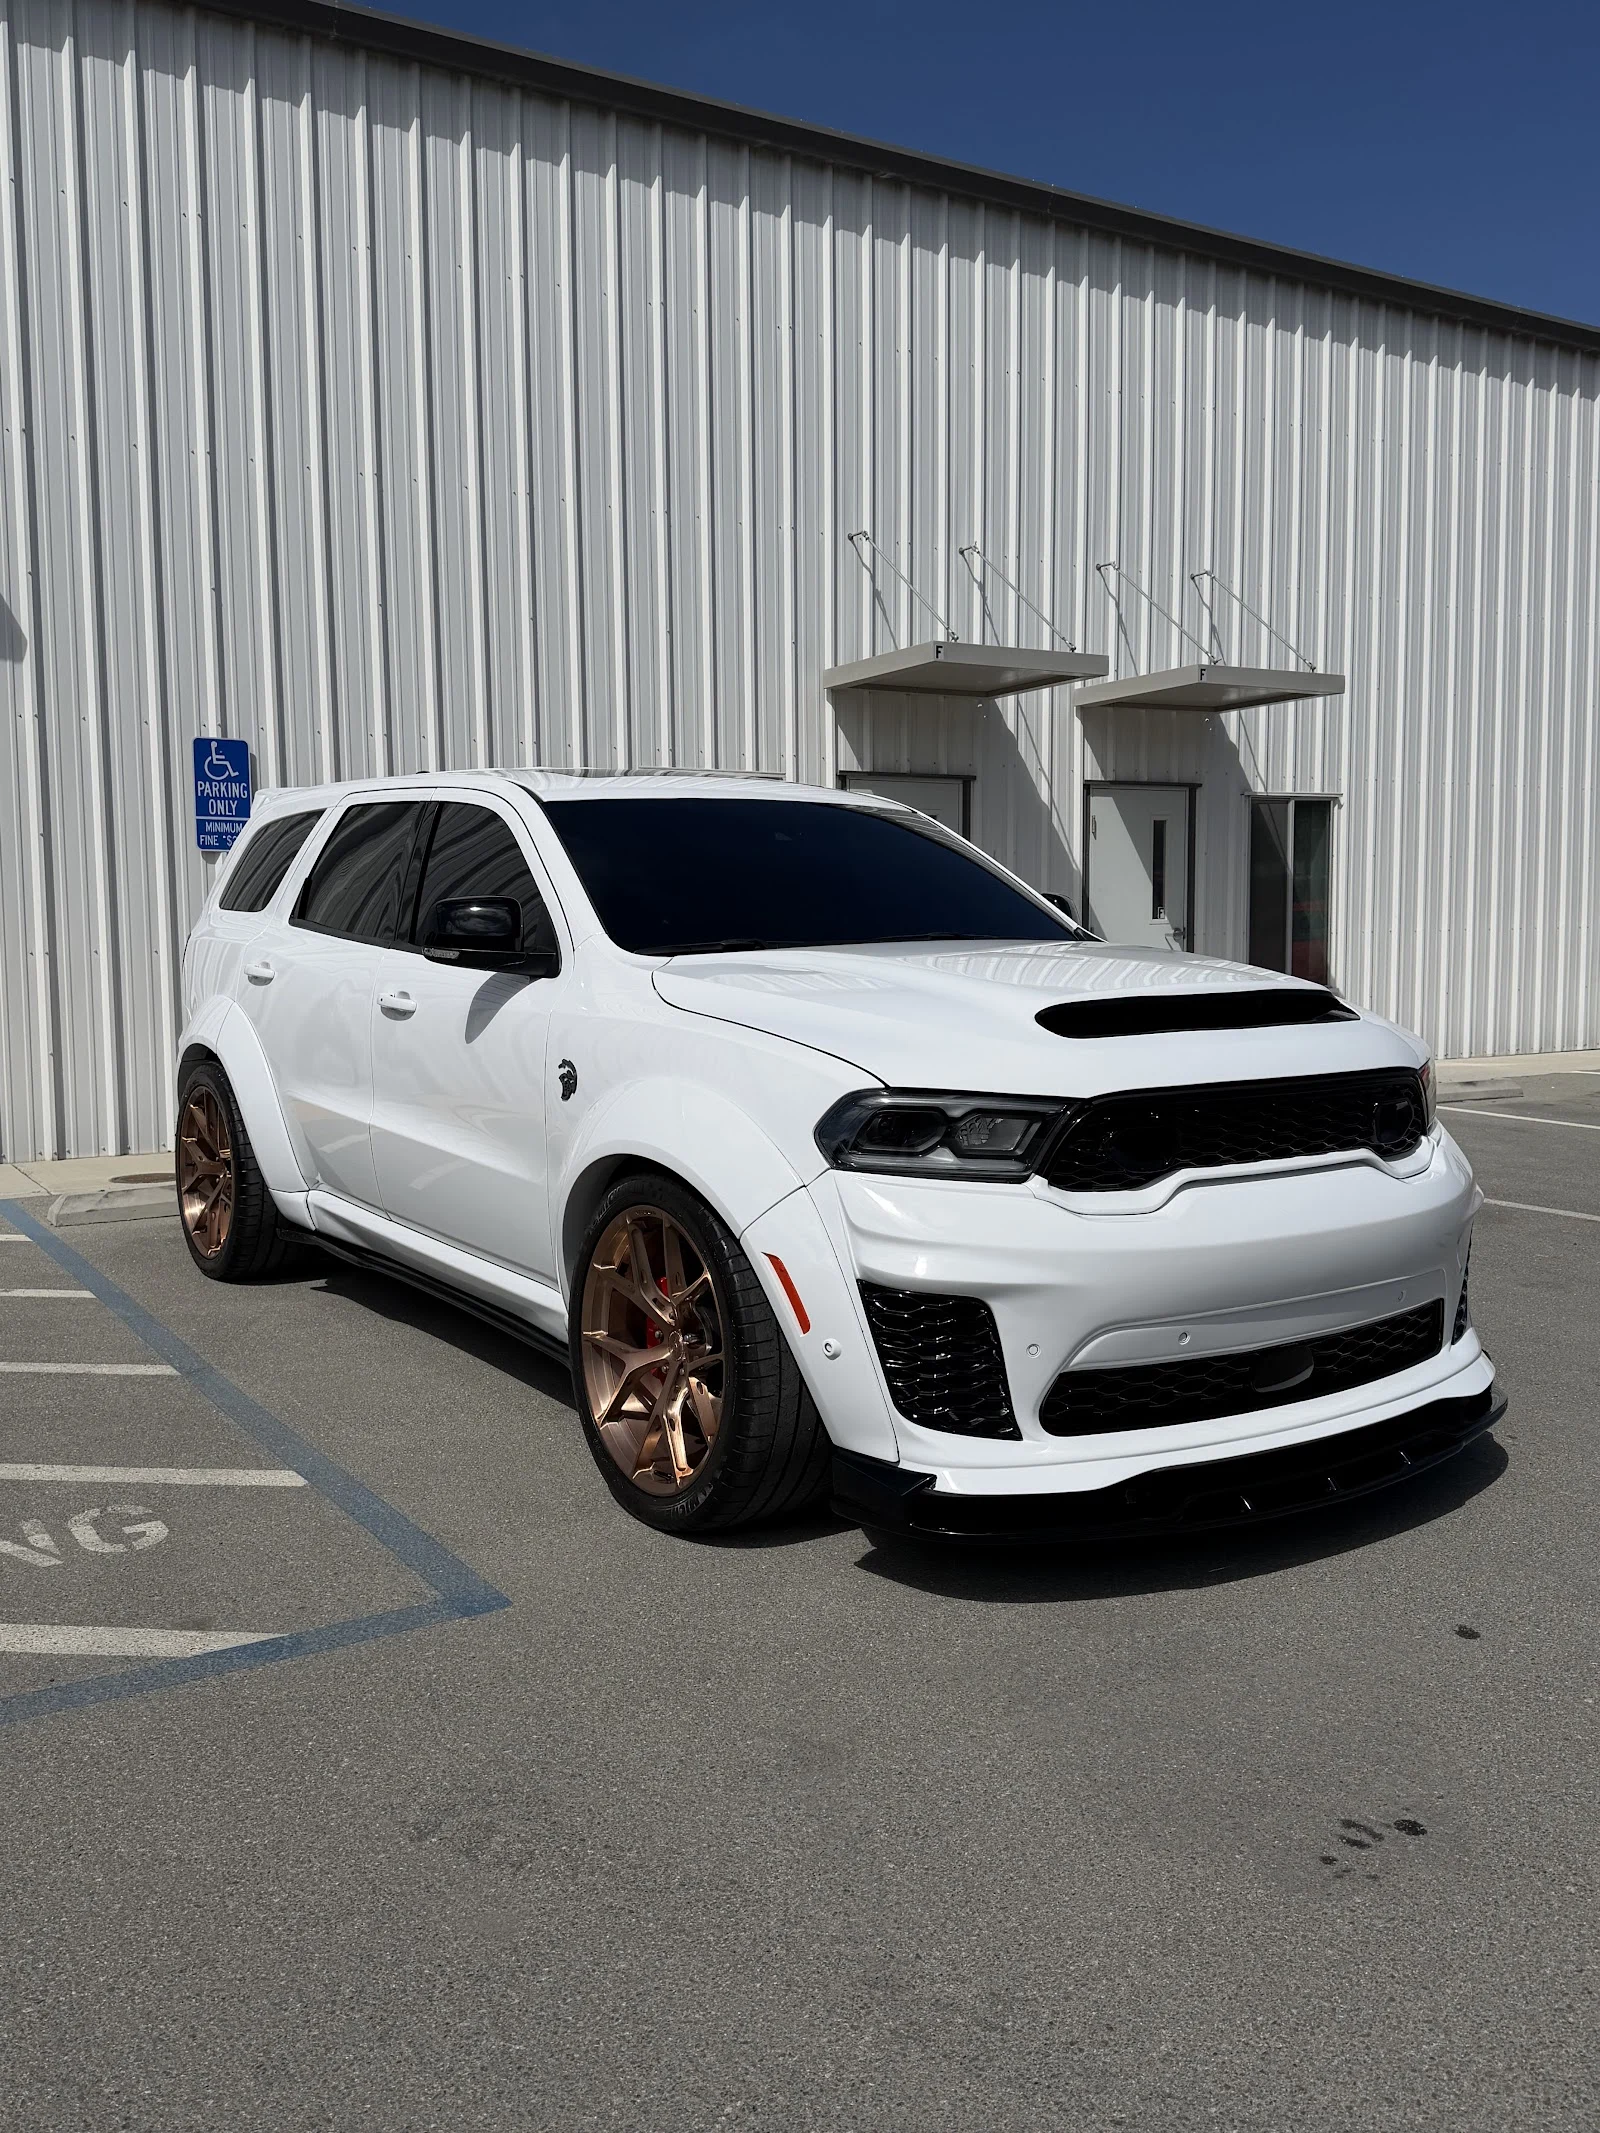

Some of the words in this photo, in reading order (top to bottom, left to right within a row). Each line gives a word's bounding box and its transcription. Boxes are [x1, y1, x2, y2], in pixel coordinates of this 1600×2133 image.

[936, 645, 943, 659] F
[1200, 668, 1206, 681] F
[197, 781, 248, 798] PARKING
[208, 799, 238, 816] ONLY
[205, 821, 243, 833] MINIMUM
[200, 834, 219, 846] FINE
